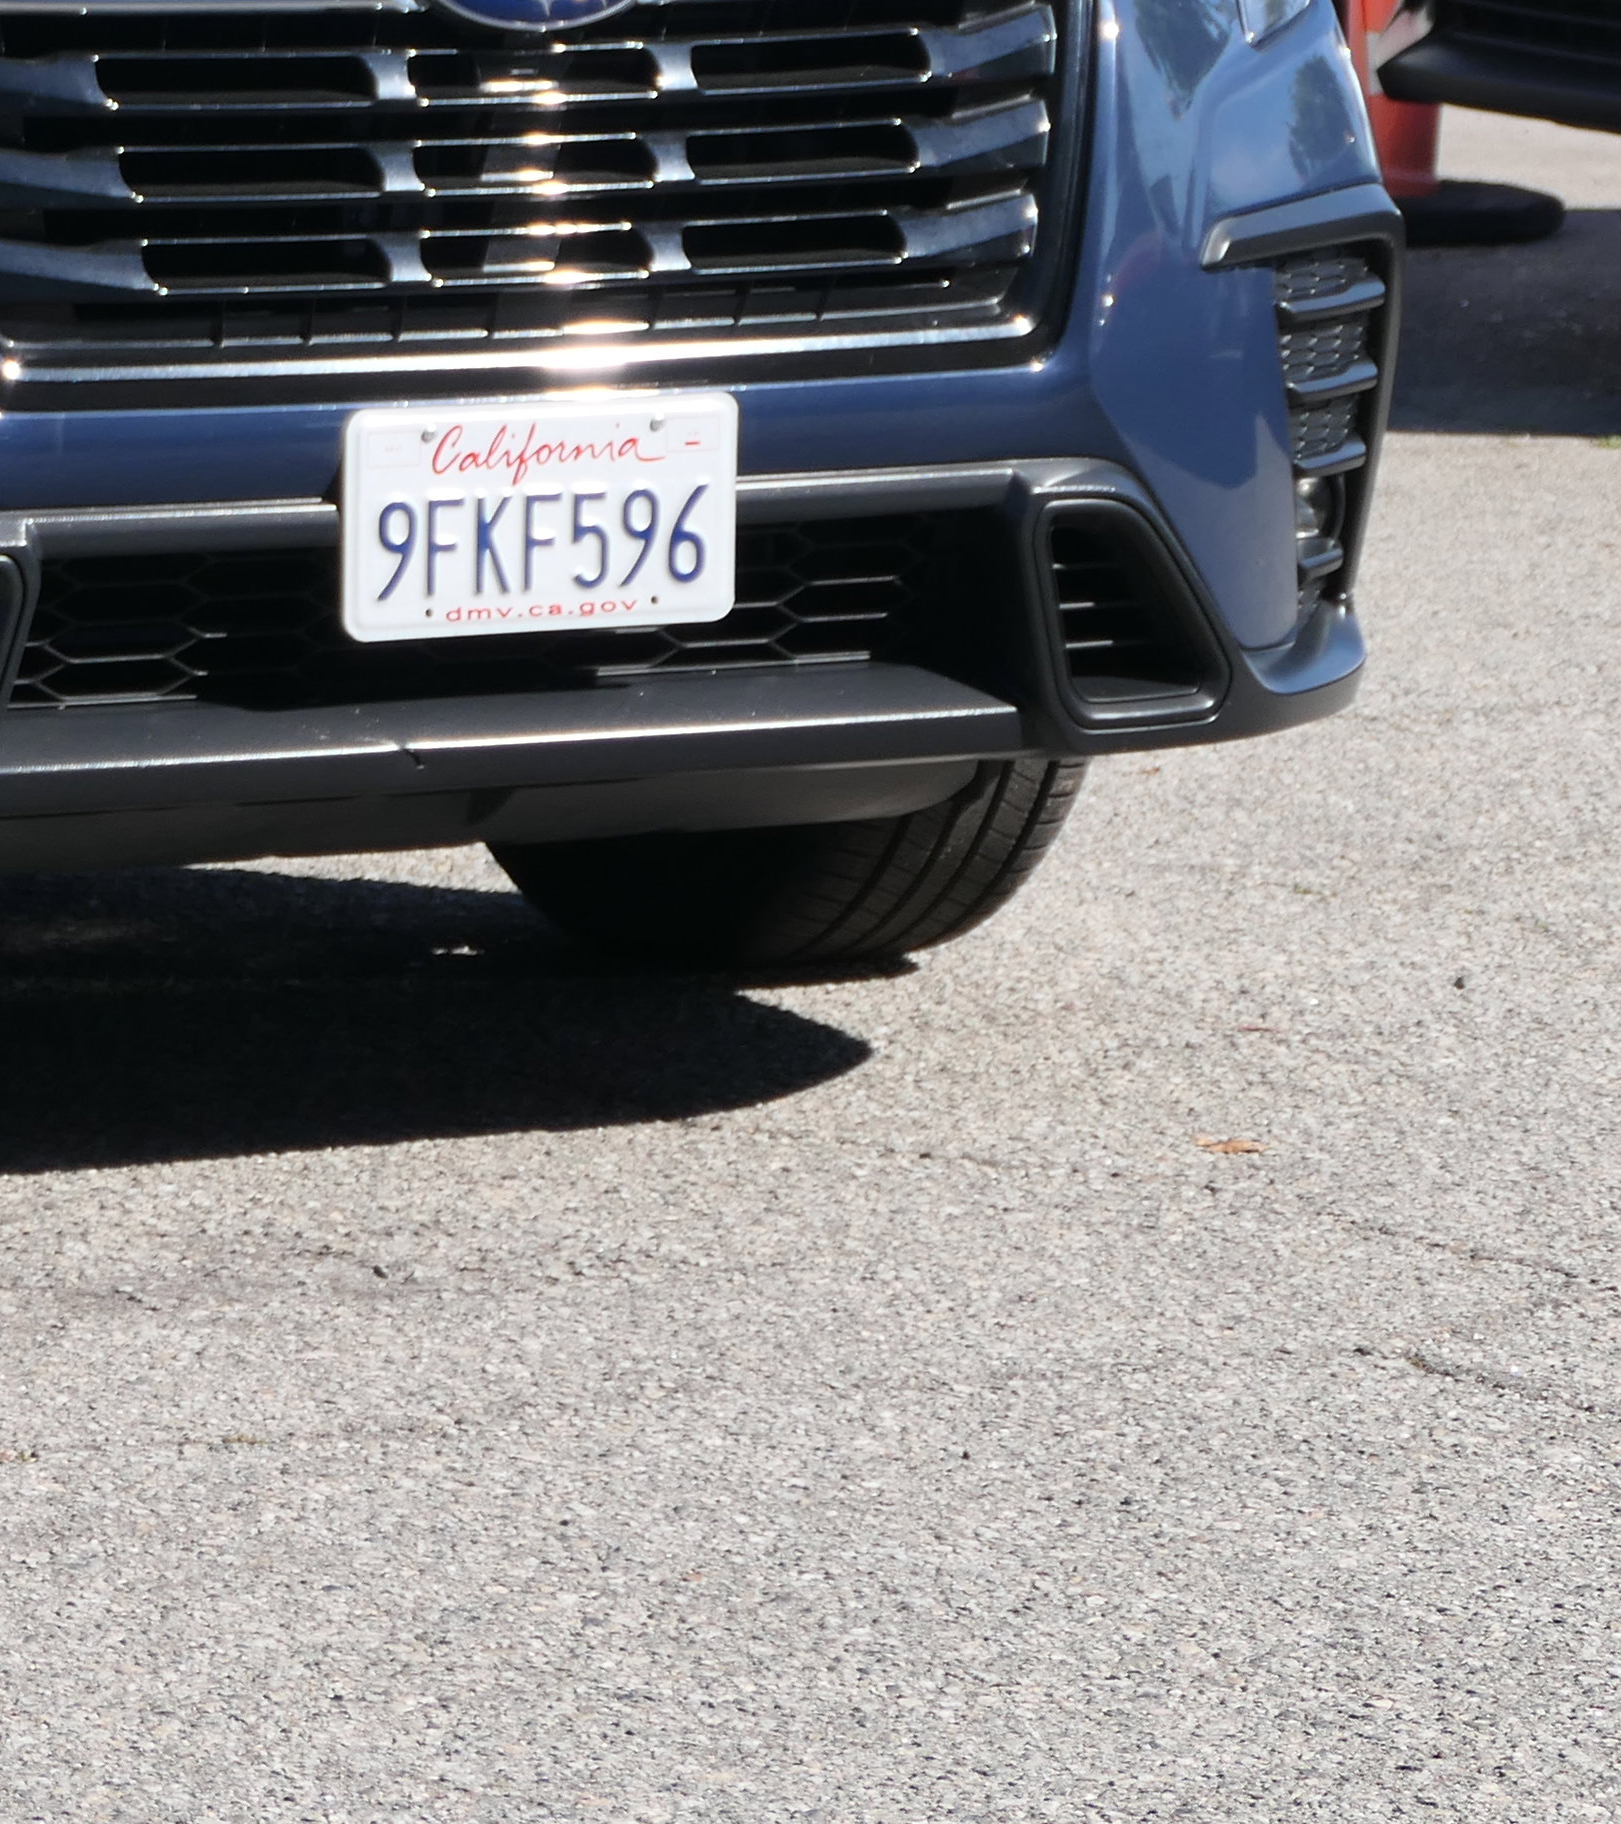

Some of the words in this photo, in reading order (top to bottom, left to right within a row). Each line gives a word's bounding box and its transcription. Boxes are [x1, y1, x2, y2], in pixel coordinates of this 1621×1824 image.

[431, 422, 665, 486] California
[376, 482, 709, 602] 9FKF596
[445, 598, 638, 623] dmv.ca.gov
